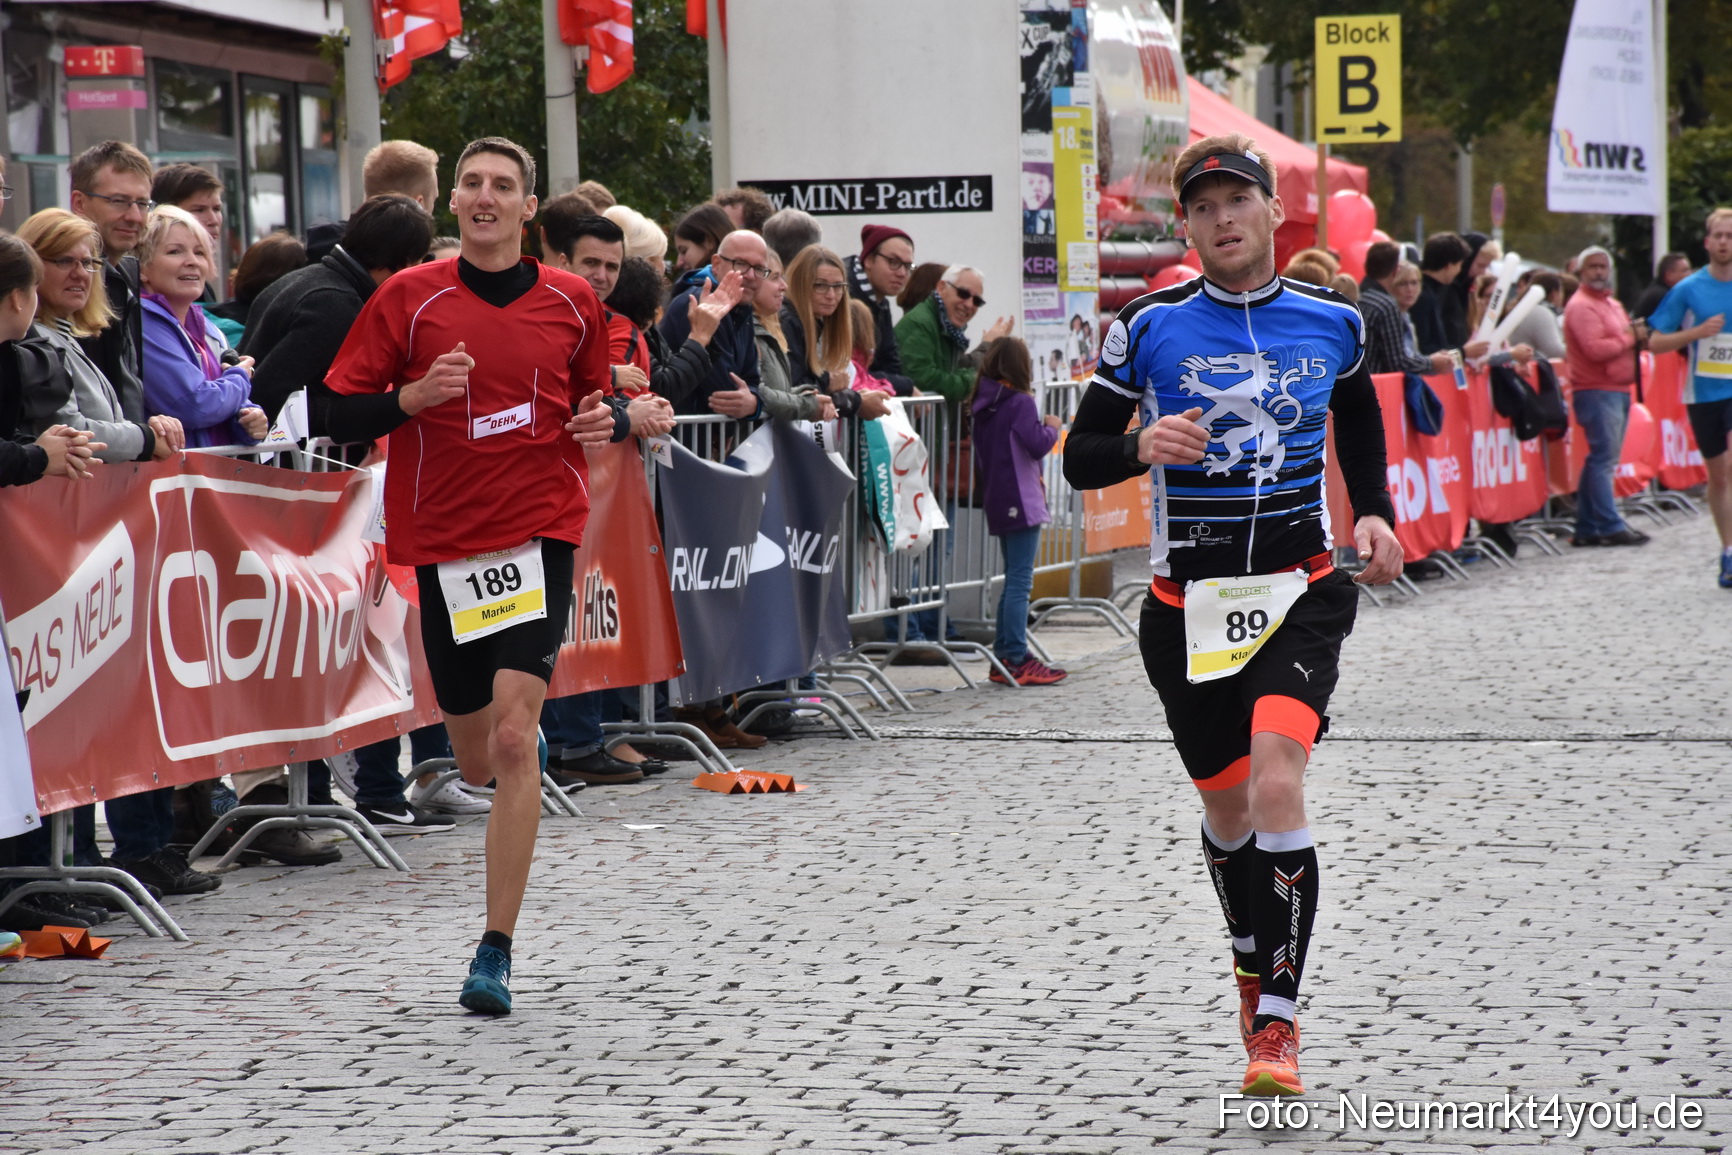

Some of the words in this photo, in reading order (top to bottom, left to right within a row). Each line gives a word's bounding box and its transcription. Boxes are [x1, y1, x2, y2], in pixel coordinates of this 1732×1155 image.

[1326, 21, 1390, 44] Block
[1338, 54, 1380, 115] B
[490, 413, 517, 430] DEHN
[465, 562, 523, 602] 189
[1230, 585, 1272, 597] BOCK
[71, 556, 124, 670] NEUE
[481, 602, 517, 621] Markus
[582, 570, 619, 641] Hits
[1226, 609, 1269, 643] 89
